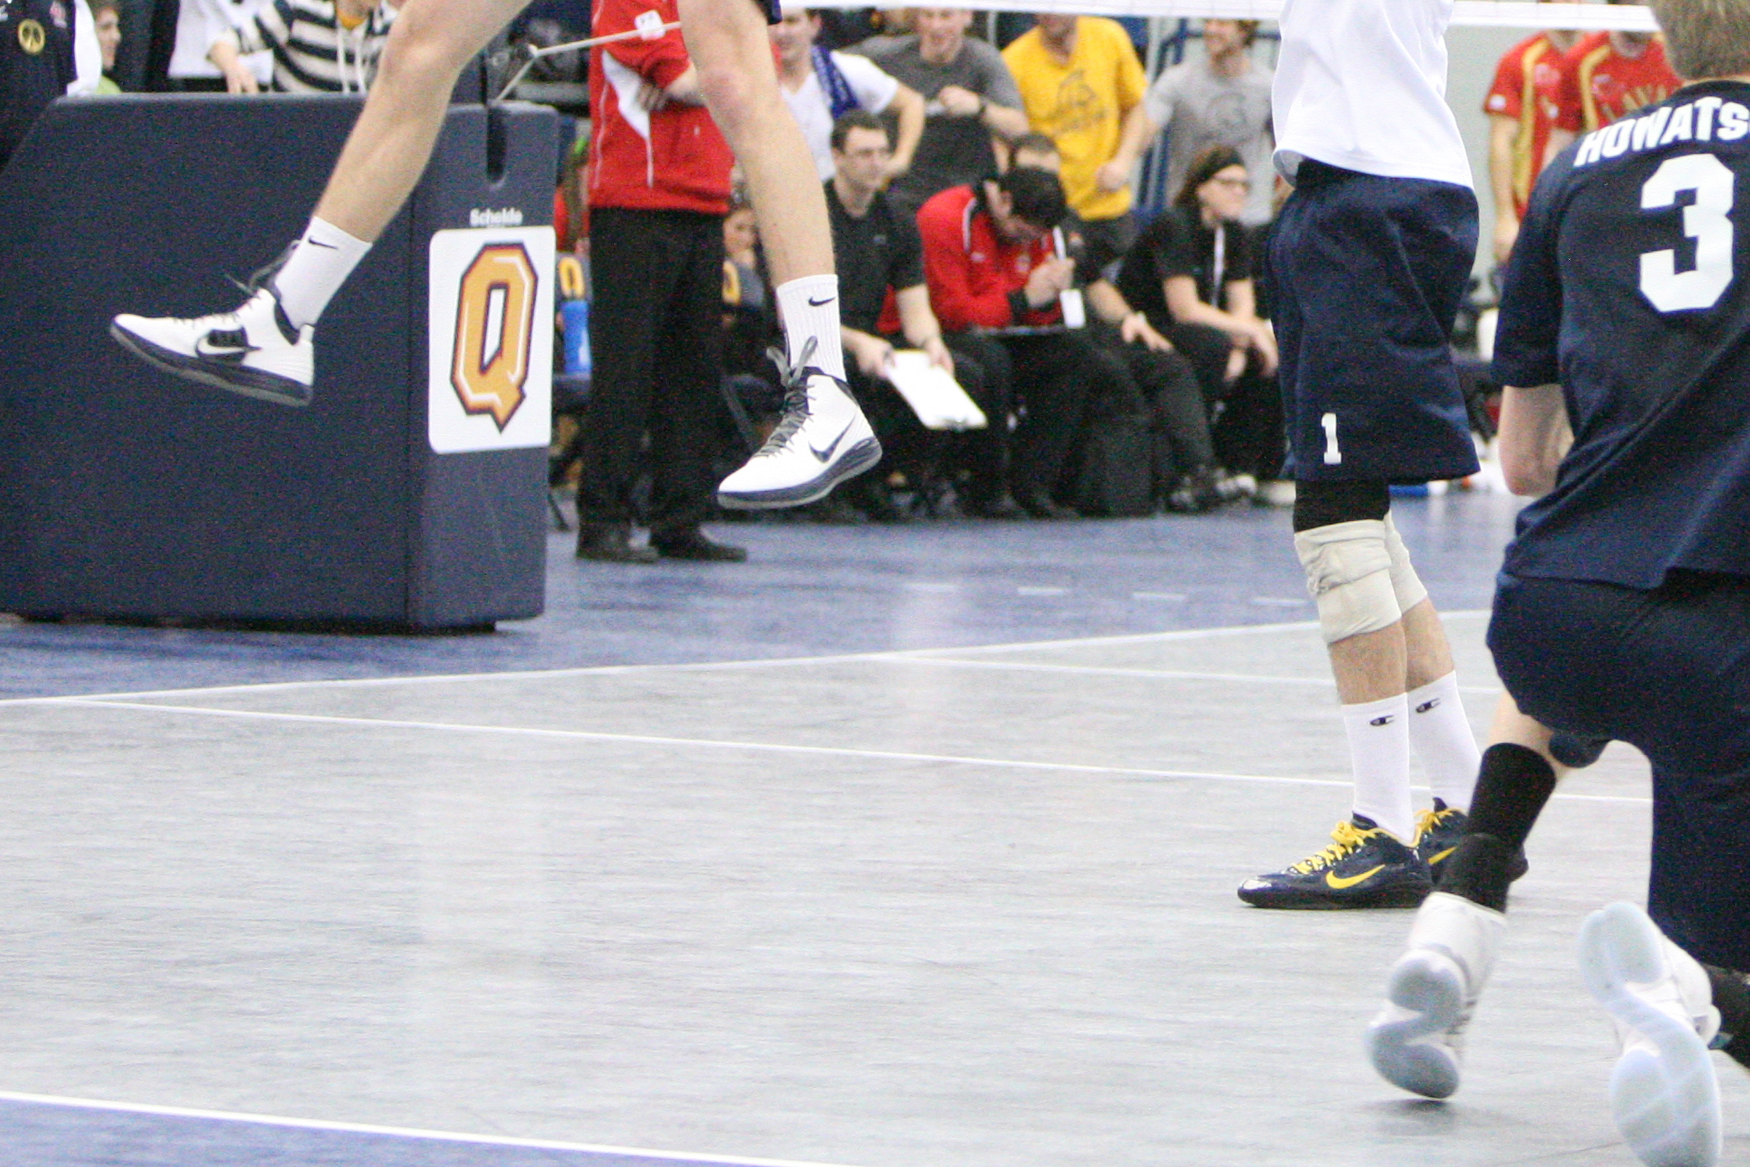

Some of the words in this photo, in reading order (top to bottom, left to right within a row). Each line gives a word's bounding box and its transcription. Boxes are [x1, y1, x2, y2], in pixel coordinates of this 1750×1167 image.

[1639, 153, 1735, 312] 3
[450, 241, 538, 434] Q
[1321, 413, 1342, 464] 1
